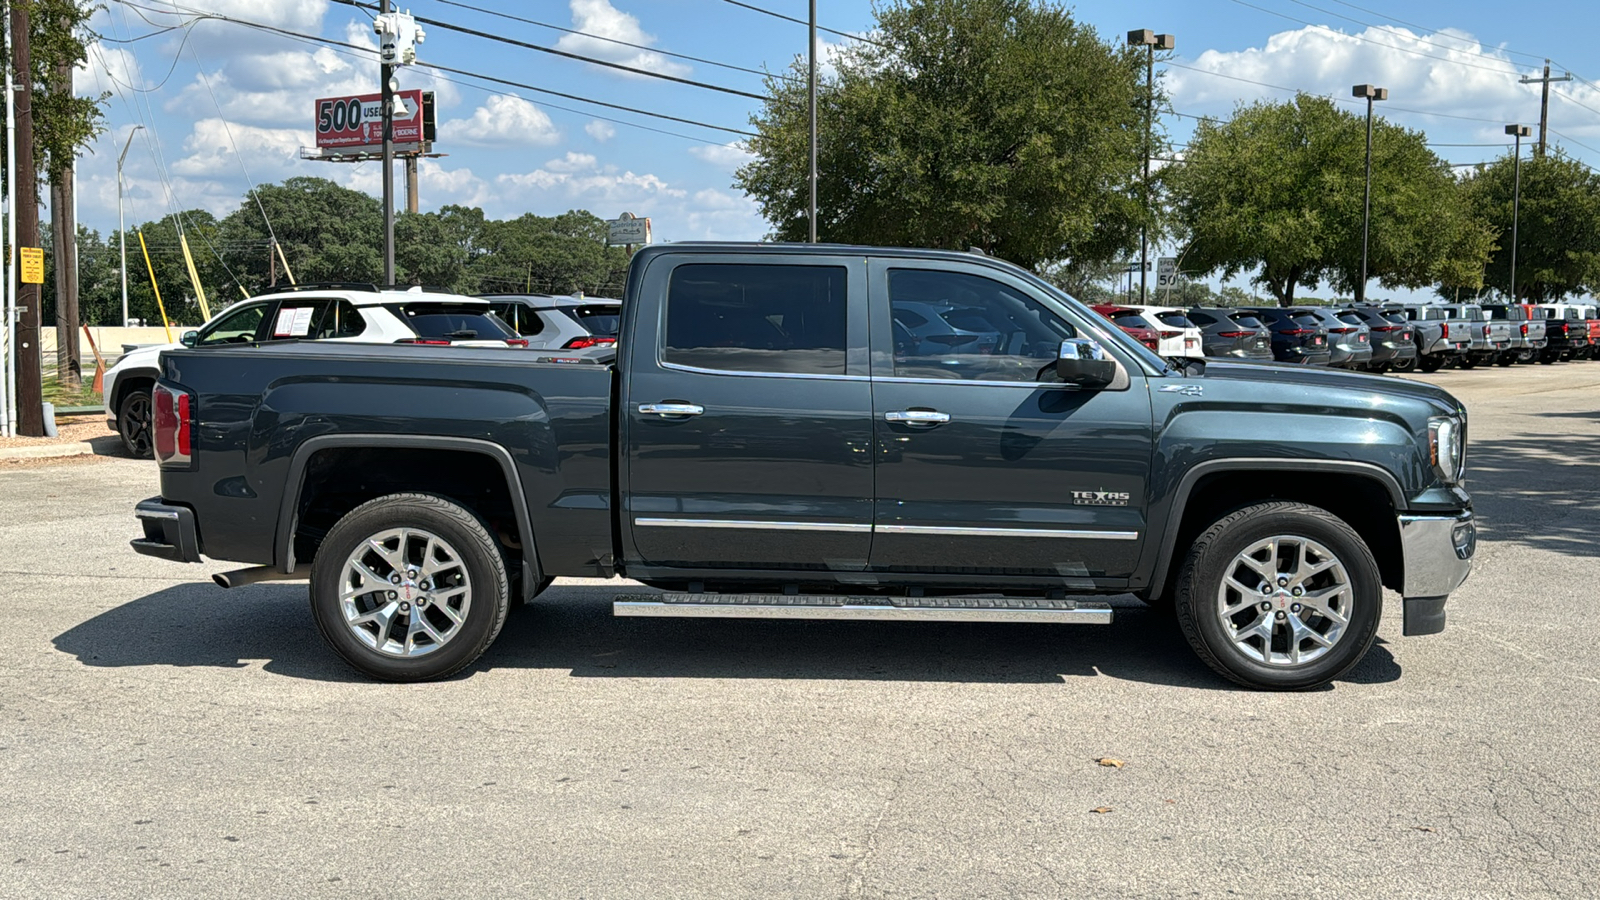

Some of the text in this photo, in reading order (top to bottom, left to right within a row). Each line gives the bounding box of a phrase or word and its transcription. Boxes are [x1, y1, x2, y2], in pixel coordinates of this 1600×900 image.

[318, 98, 361, 133] 500
[1159, 275, 1176, 286] 50
[1070, 487, 1130, 501] TEXAS
